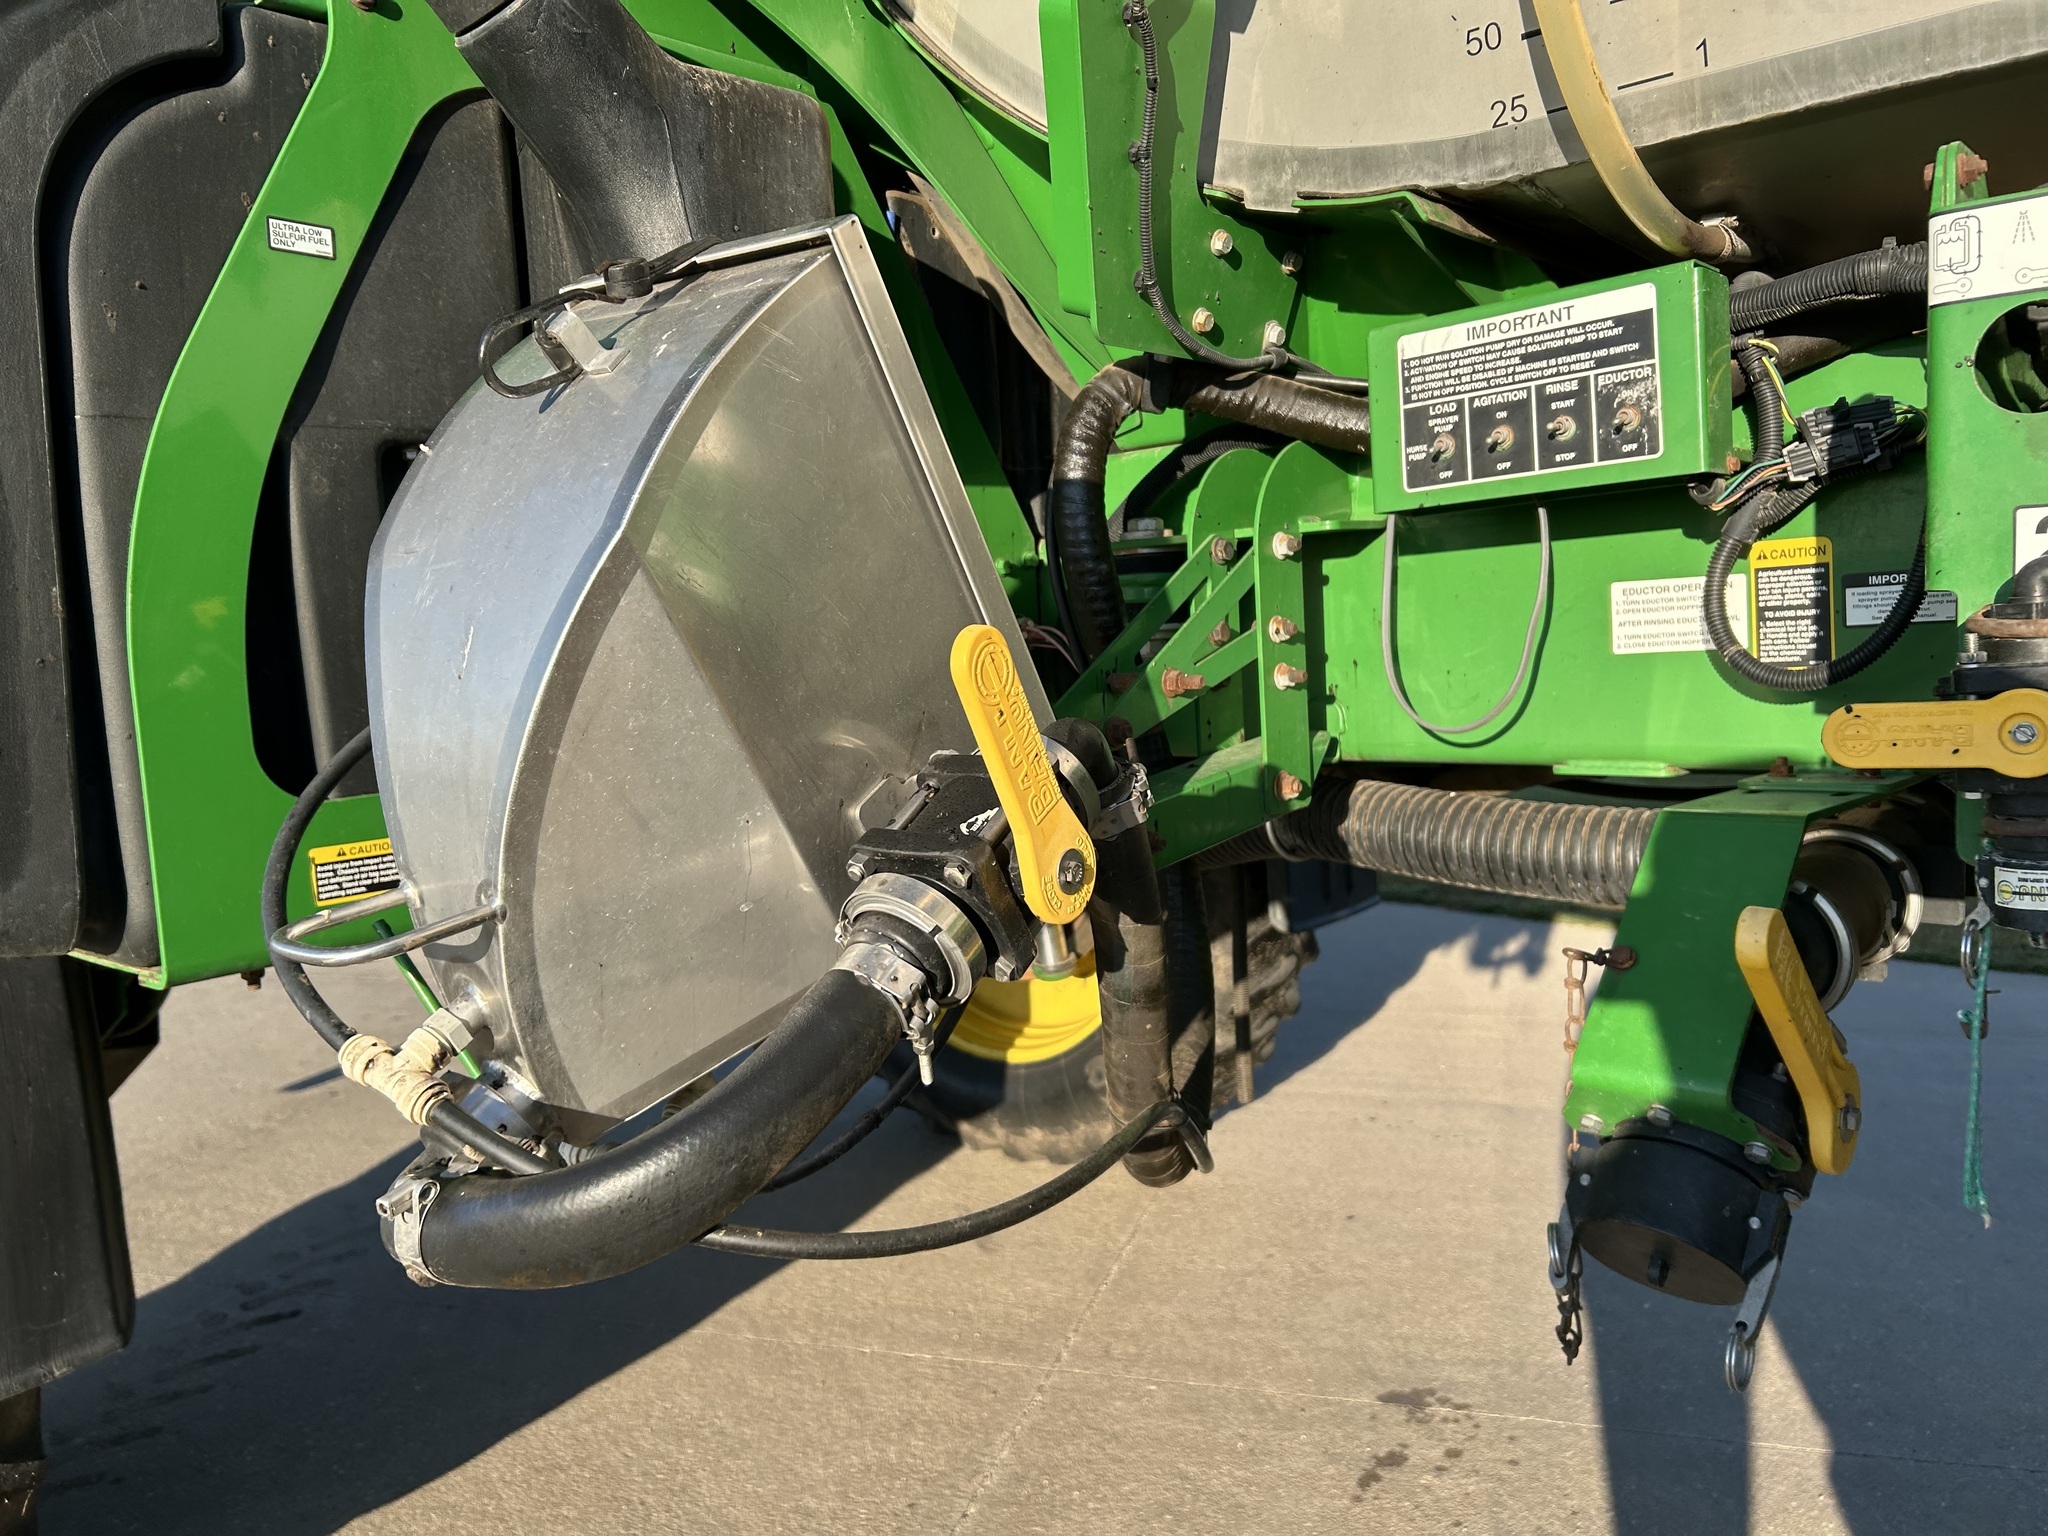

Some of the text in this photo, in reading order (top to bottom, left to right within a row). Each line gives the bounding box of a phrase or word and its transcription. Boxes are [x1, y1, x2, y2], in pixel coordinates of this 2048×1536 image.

[1466, 22, 1502, 57] 50
[1696, 38, 1708, 67] 1
[1490, 94, 1528, 129] 25
[272, 222, 322, 237] ULTRA LOW
[272, 230, 329, 246] SULFUR FUEL
[273, 238, 296, 248] ONLY
[1466, 305, 1575, 341] IMPORTANT
[1410, 360, 1419, 368] DO
[1421, 356, 1434, 366] NOT
[1436, 353, 1449, 363] RUN
[1451, 346, 1484, 360] SOLUTION
[1486, 342, 1505, 352] PUMP
[1506, 339, 1520, 348] DRY
[1522, 336, 1532, 345] OR
[1534, 330, 1565, 342] DAMAGE
[1567, 326, 1584, 336] WILL
[1586, 319, 1614, 332] OCCUR.
[1411, 362, 1447, 376] ACTIVATION
[1448, 360, 1457, 369] OF
[1459, 355, 1485, 366] SWITCH
[1486, 352, 1500, 361] MAY
[1502, 347, 1526, 358] CAUSE
[1528, 339, 1563, 353] SOLUTION
[1565, 335, 1586, 345] PUMP
[1587, 332, 1598, 341] TO
[1599, 327, 1623, 338] START
[1411, 380, 1443, 393] FUNCTION
[1445, 377, 1460, 387] WILL
[1462, 375, 1471, 383] BE
[1472, 368, 1506, 381] DISABLED
[1515, 360, 1548, 373] MACHINE
[1557, 352, 1591, 365] STARTED
[1592, 349, 1608, 358] AND
[1610, 343, 1639, 355] SWITCH
[1411, 356, 1521, 385] AND ENGINE SPEED TO INCREASE.
[1419, 390, 1432, 399] NOT
[1442, 386, 1454, 395] OFF
[1456, 380, 1488, 392] POSITION.
[1490, 376, 1513, 386] CYCLE
[1514, 370, 1542, 382] SWITCH
[1543, 368, 1557, 376] OFF
[1559, 365, 1569, 374] TO
[1570, 360, 1596, 371] RESET.
[1598, 366, 1652, 386] EDUCTOR
[1546, 380, 1579, 395] RINSE
[1473, 390, 1527, 408] AGITATION
[1551, 399, 1576, 410] START
[1429, 402, 1457, 415] LOAD
[1496, 411, 1508, 419] ON
[1428, 415, 1458, 427] SPRAYER
[1434, 424, 1454, 433] PUMP
[1406, 444, 1428, 454] NURSE
[1622, 443, 1638, 452] OFF
[1409, 453, 1426, 461] PUMP
[1556, 452, 1576, 462] STOP
[1497, 462, 1512, 470] OFF
[1439, 470, 1453, 479] OFF
[1770, 545, 1826, 560] CAUTION
[1869, 574, 1908, 584] IMPOR
[1622, 585, 1670, 596] EDUCTOR
[1644, 618, 1675, 626] RINSING
[349, 842, 392, 855] CAUTIO
